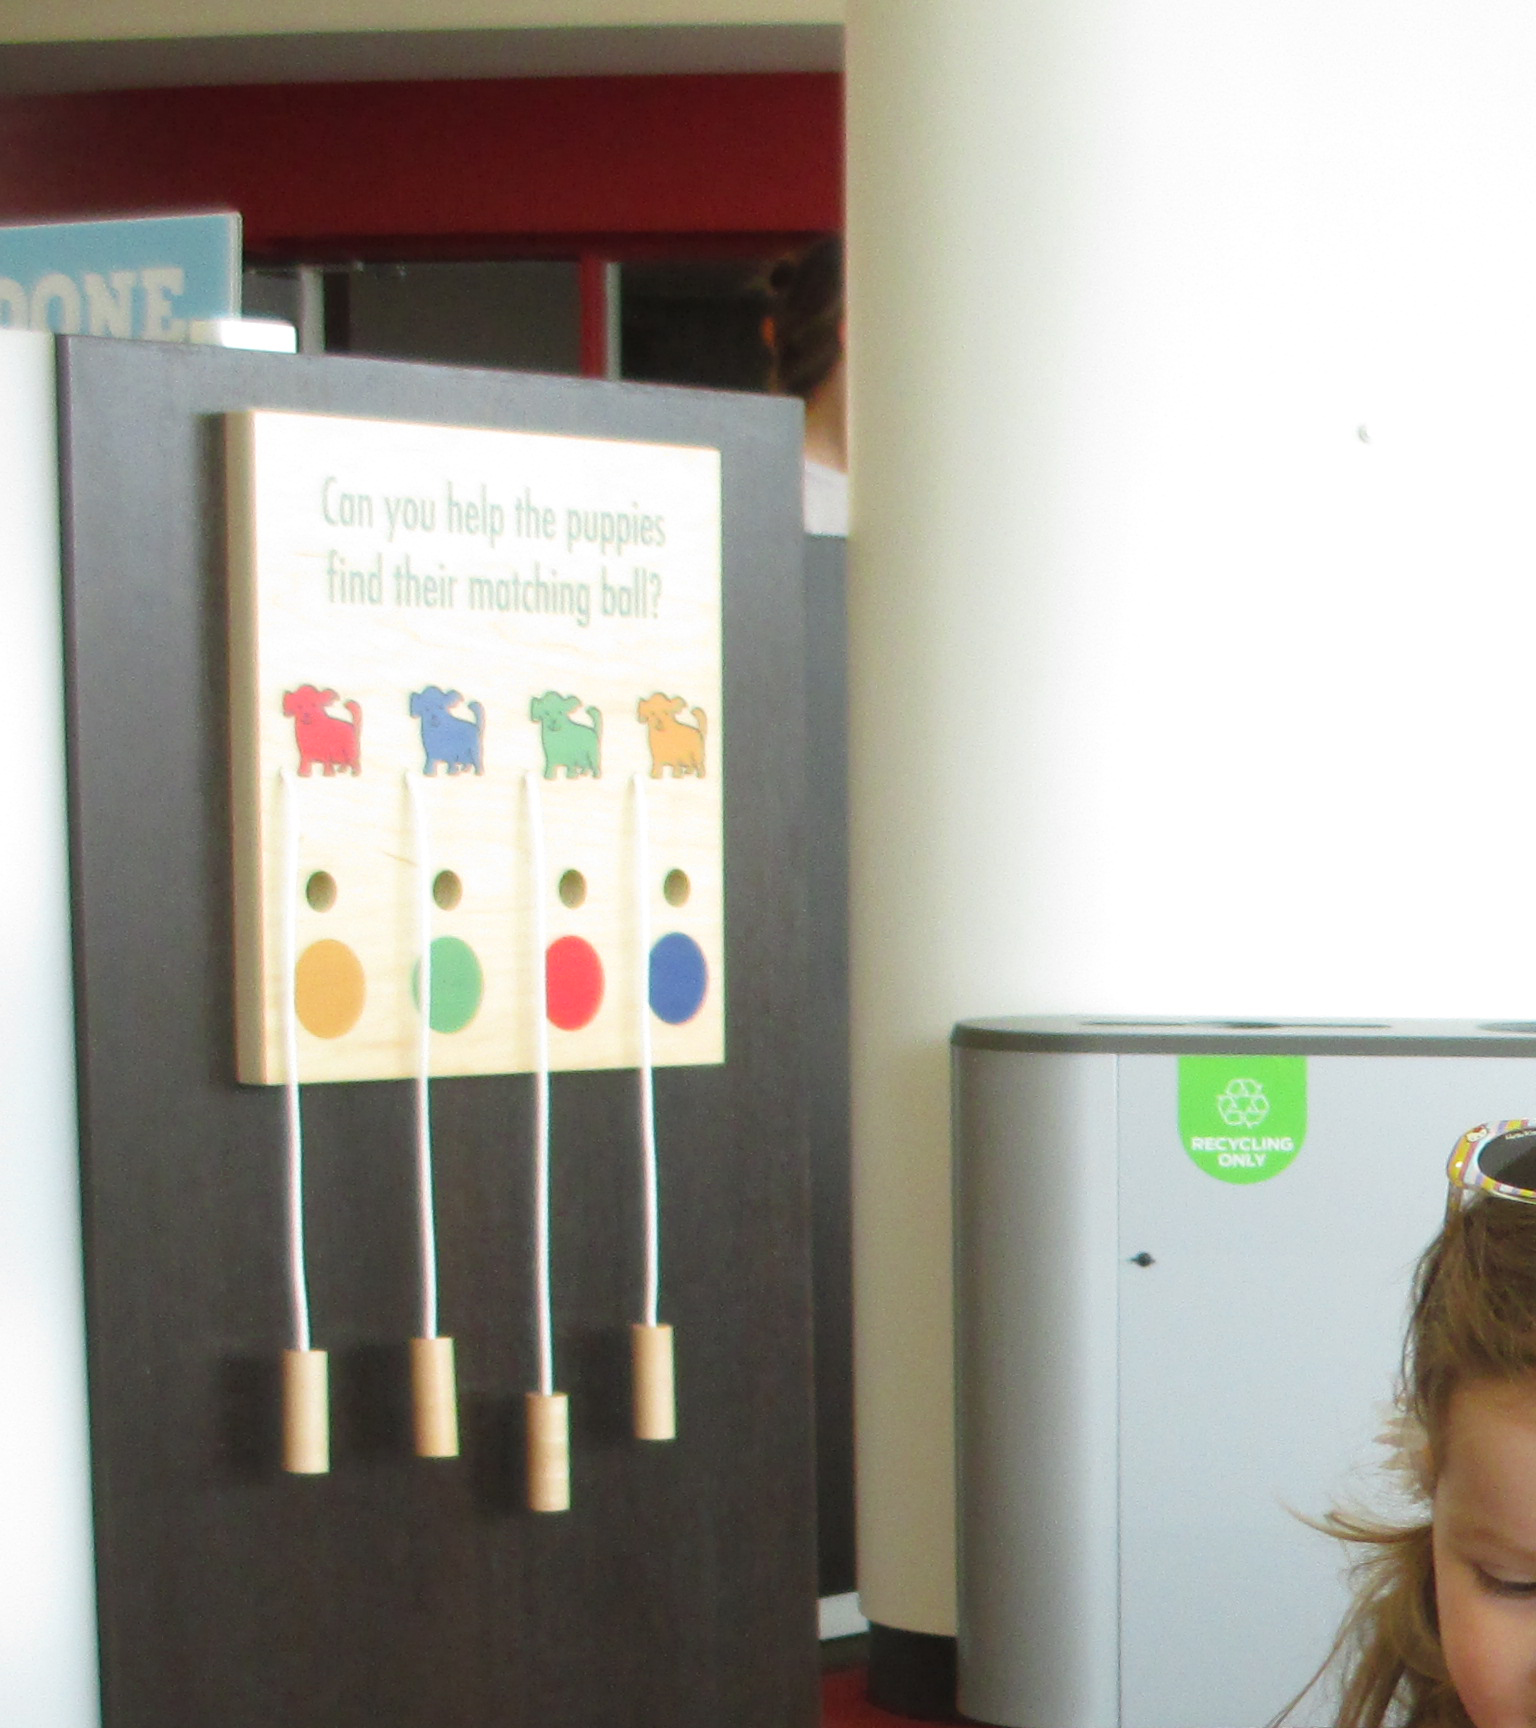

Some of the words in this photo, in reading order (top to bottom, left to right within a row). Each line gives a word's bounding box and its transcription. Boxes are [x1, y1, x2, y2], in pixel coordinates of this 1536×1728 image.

[320, 475, 373, 528] Can
[385, 495, 436, 542] you
[446, 479, 504, 548] help
[514, 486, 556, 539] the
[566, 500, 667, 556] puppies
[326, 549, 383, 604] find
[394, 553, 457, 608] their
[467, 560, 592, 628] matching
[600, 565, 662, 619] ball?
[1191, 1136, 1296, 1152] RECYCLING
[1217, 1152, 1267, 1168] ONLY
